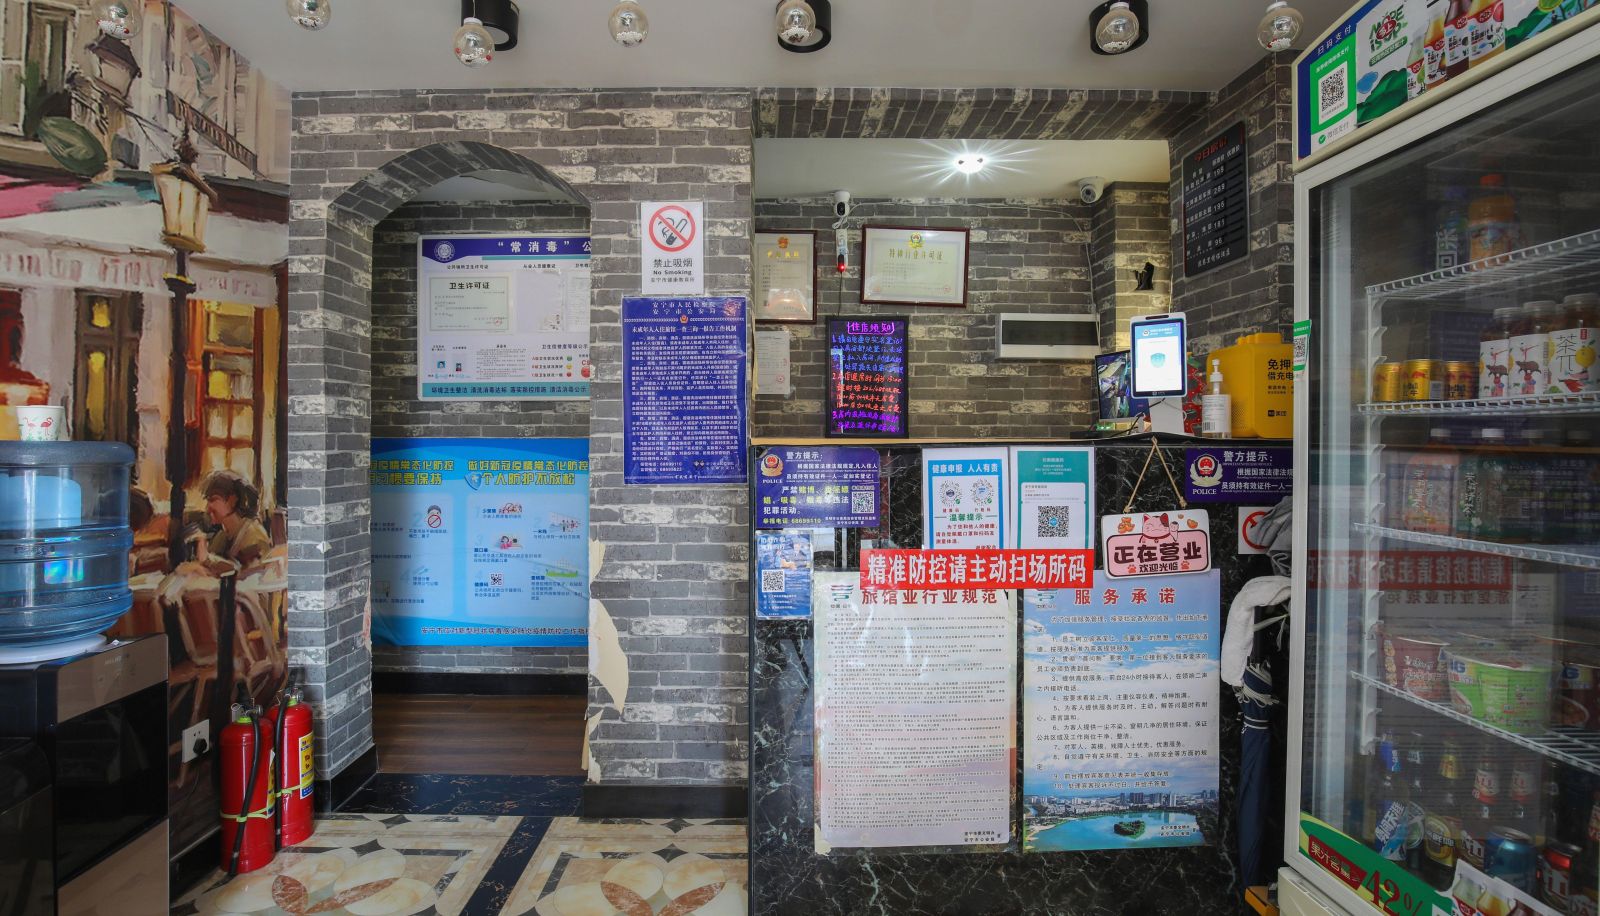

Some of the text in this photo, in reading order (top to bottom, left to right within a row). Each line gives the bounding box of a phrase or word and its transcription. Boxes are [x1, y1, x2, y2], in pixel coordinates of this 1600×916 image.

[1317, 24, 1352, 55] 扫码支付
[654, 258, 692, 267] 禁止吸烟
[449, 282, 490, 290] 卫生许可证
[851, 321, 891, 333] 住店须知
[1223, 451, 1273, 462] 警方提示:
[468, 460, 588, 471] 做好新冠疫情常态化防控
[932, 463, 999, 473] 健康申报 人人有责
[481, 473, 576, 485] 个人防护不放松
[763, 506, 801, 515] 犯罪活动。
[949, 513, 983, 521] 温馨提示
[1114, 541, 1202, 564] 正在营业
[868, 554, 1086, 584] 精准防控请主动扫场所码
[1139, 562, 1178, 573] 欢迎光临
[861, 588, 998, 605] 旅馆业行业规范
[1074, 588, 1176, 605] 服务承诺
